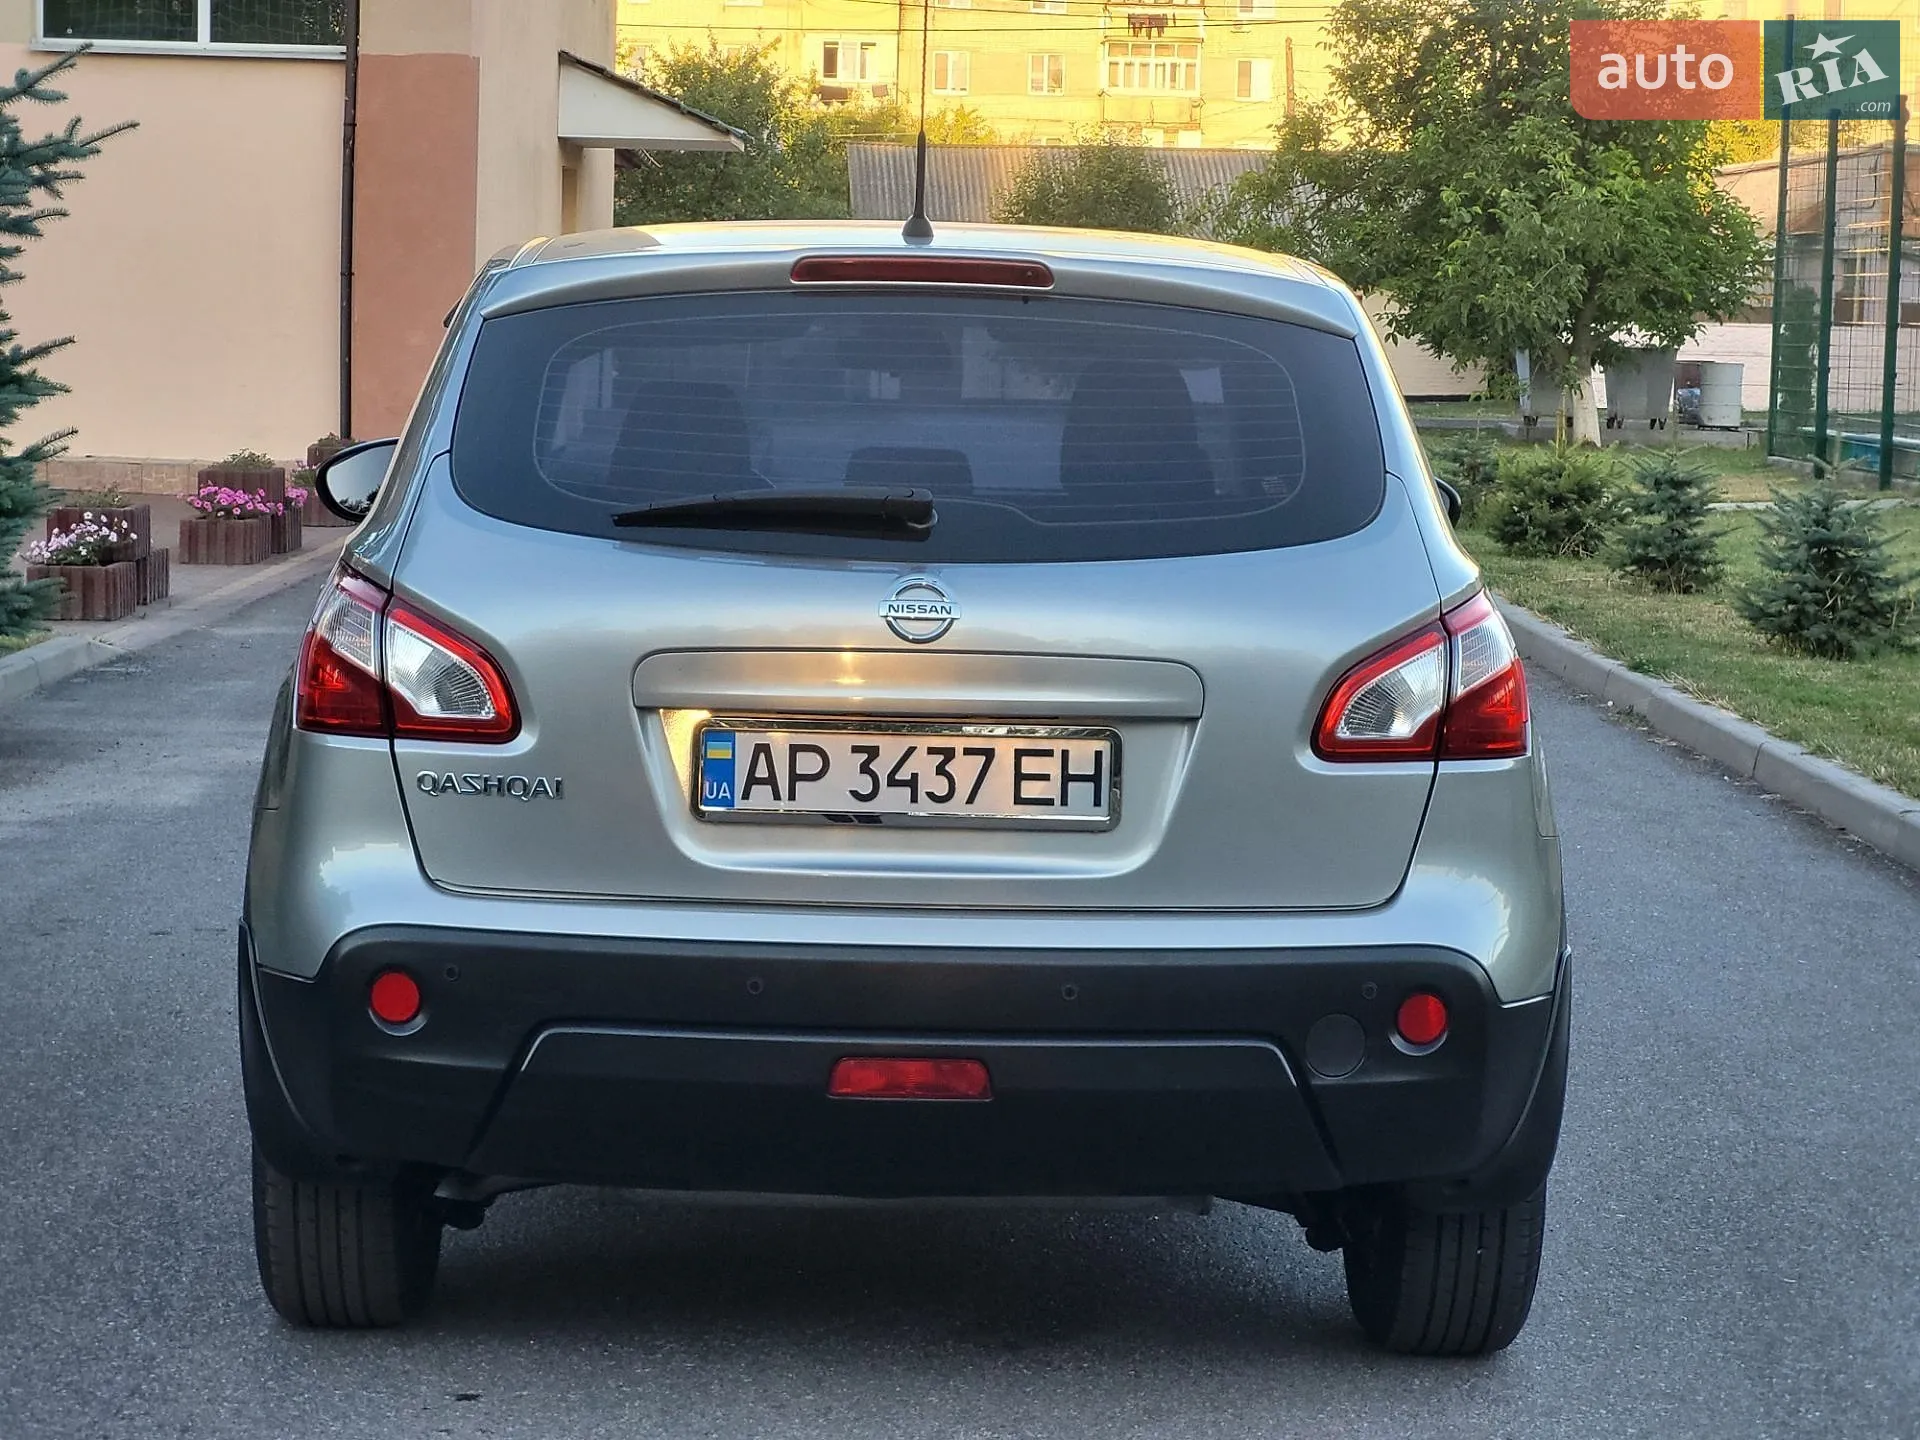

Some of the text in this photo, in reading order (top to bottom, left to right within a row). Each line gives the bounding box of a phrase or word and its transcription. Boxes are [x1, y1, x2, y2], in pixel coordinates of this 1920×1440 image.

[888, 603, 952, 615] NISSAN
[416, 770, 564, 801] QASHQAI
[741, 742, 1103, 808] AP 3437 EH
[705, 781, 731, 800] UA
